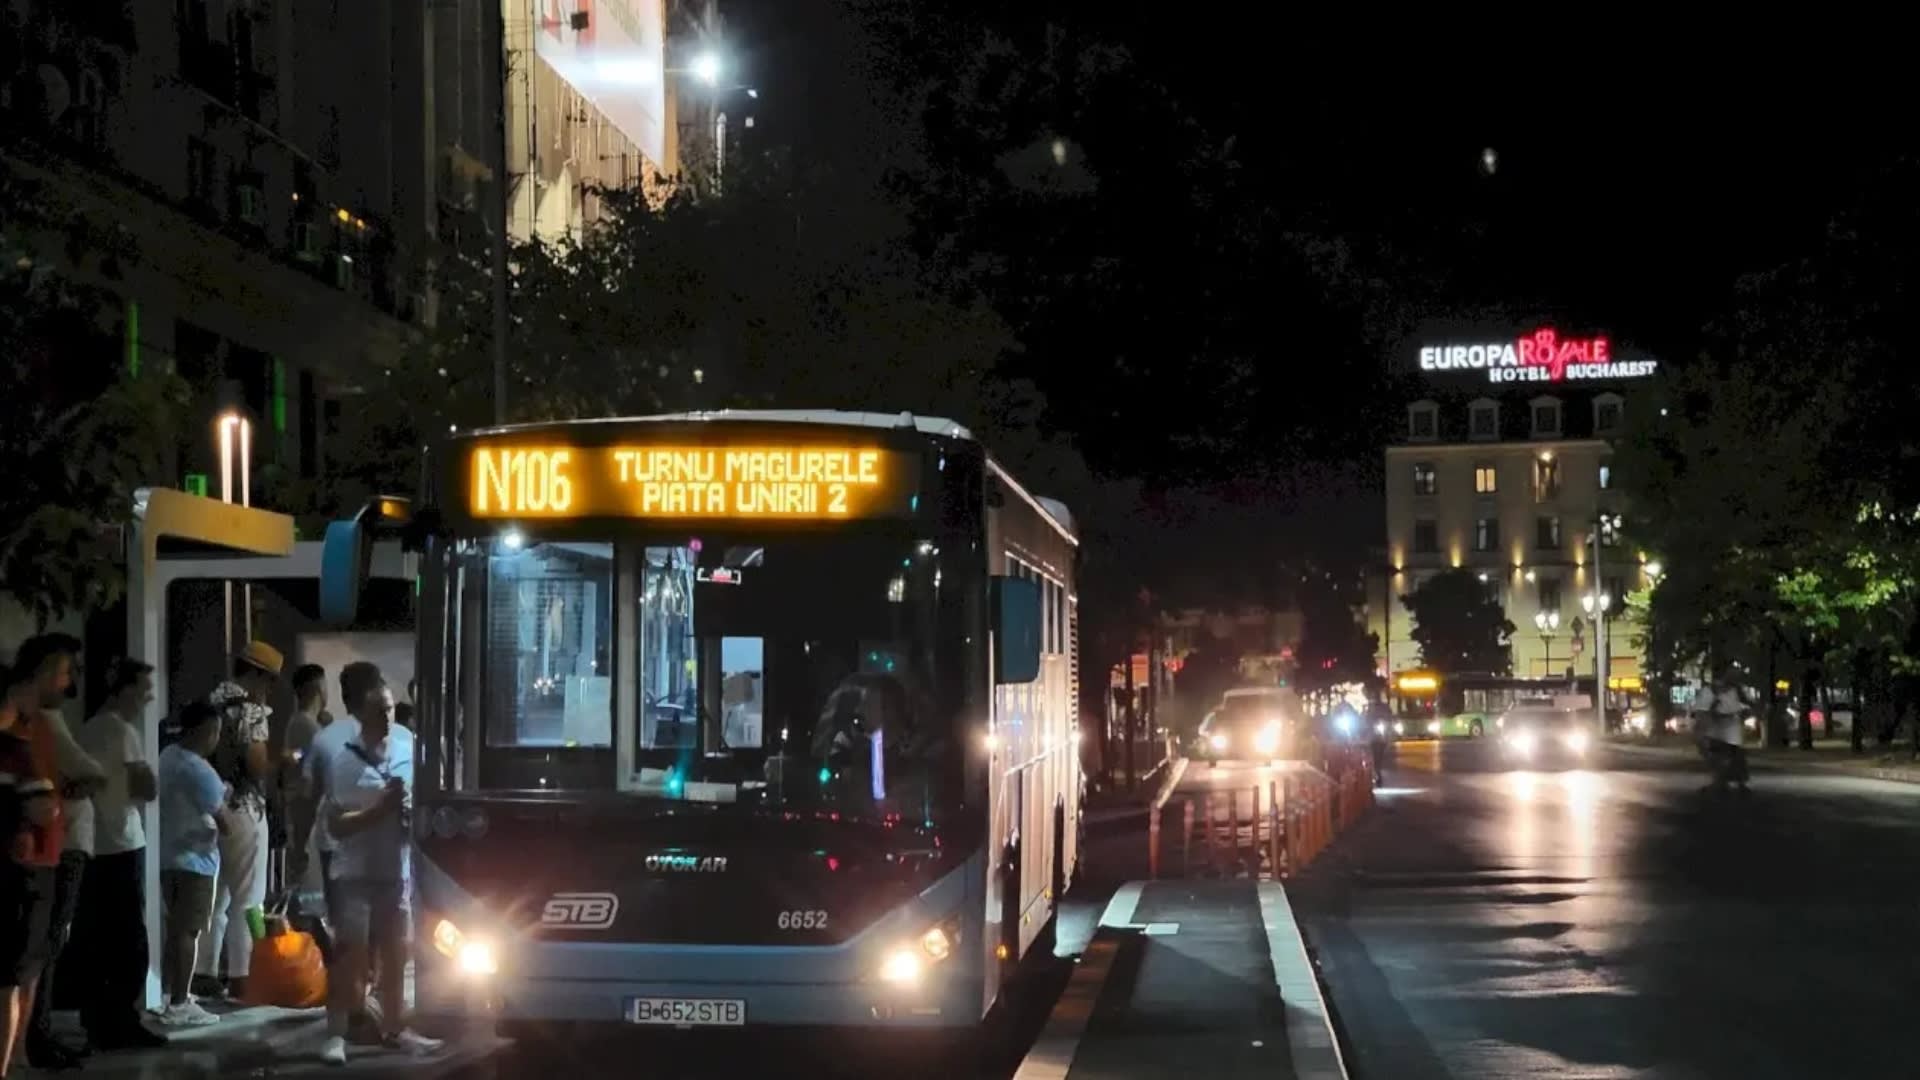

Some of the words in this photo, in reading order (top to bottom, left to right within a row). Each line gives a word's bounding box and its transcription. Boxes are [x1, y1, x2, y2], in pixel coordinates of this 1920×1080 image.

[1421, 345, 1517, 369] EUROPA
[1489, 367, 1551, 382] HOTEL
[1566, 361, 1657, 379] BUCHAREST
[614, 451, 715, 482] TURNU
[725, 451, 878, 484] MAGURELE
[476, 449, 570, 512] N106
[642, 482, 726, 513] PIATA
[736, 482, 817, 513] UNIRII
[828, 482, 847, 513] 2
[645, 855, 728, 872] OTOKAR
[542, 899, 610, 922] STB
[777, 910, 829, 929] 6652
